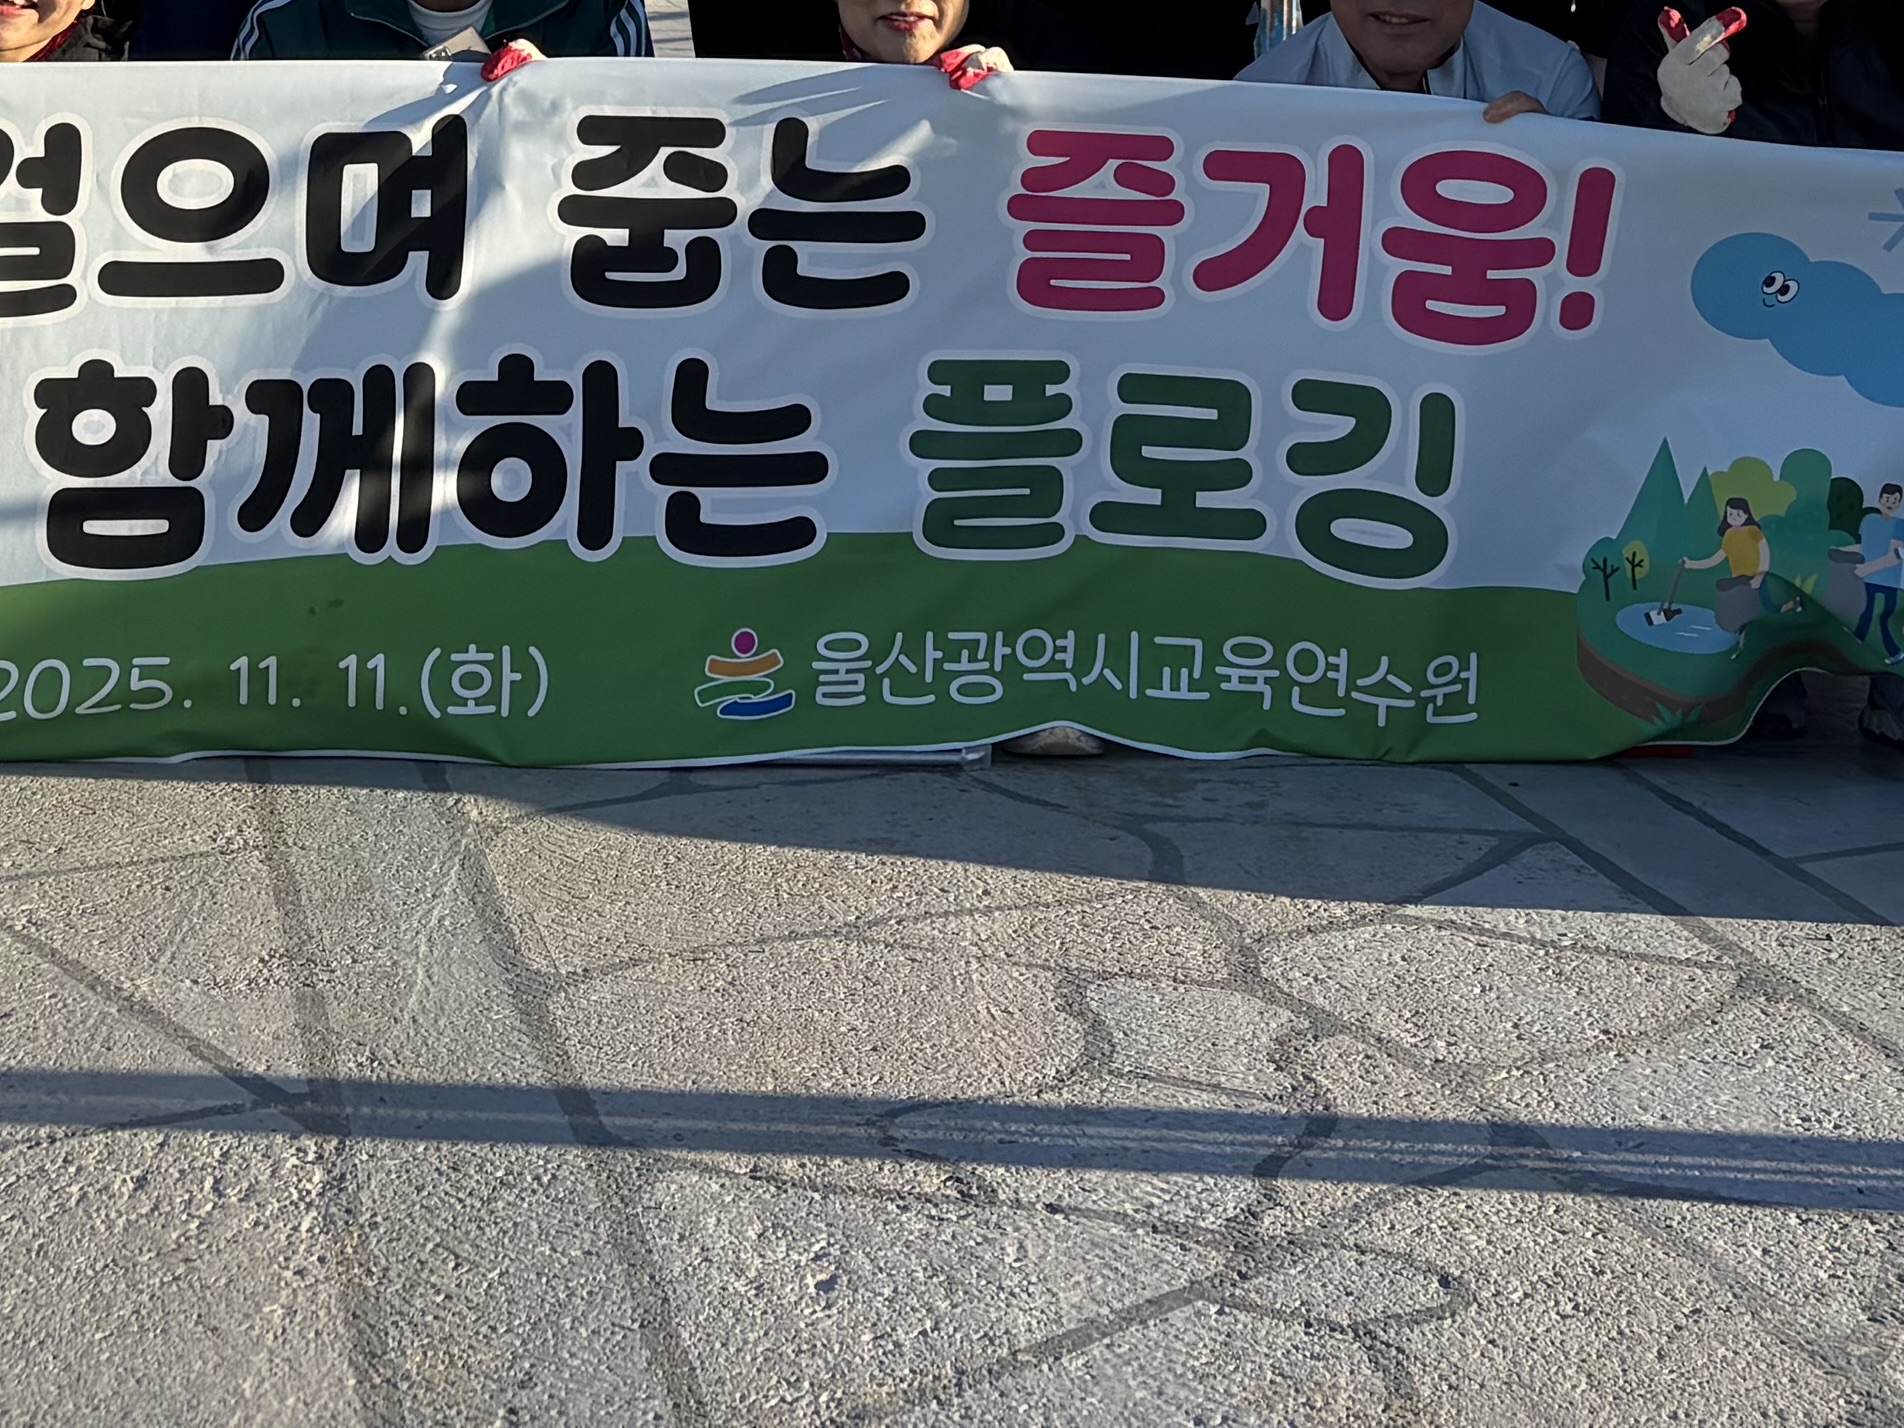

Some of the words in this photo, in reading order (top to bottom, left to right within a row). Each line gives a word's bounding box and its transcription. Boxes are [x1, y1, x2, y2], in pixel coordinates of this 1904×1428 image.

[564, 114, 927, 310] 줍는
[1008, 130, 1617, 345] 즐거움!
[34, 356, 830, 570] 함께하는
[908, 358, 1458, 581] 플로깅
[229, 655, 302, 708] 11.
[811, 627, 1479, 728] 울산광역시교육연수원
